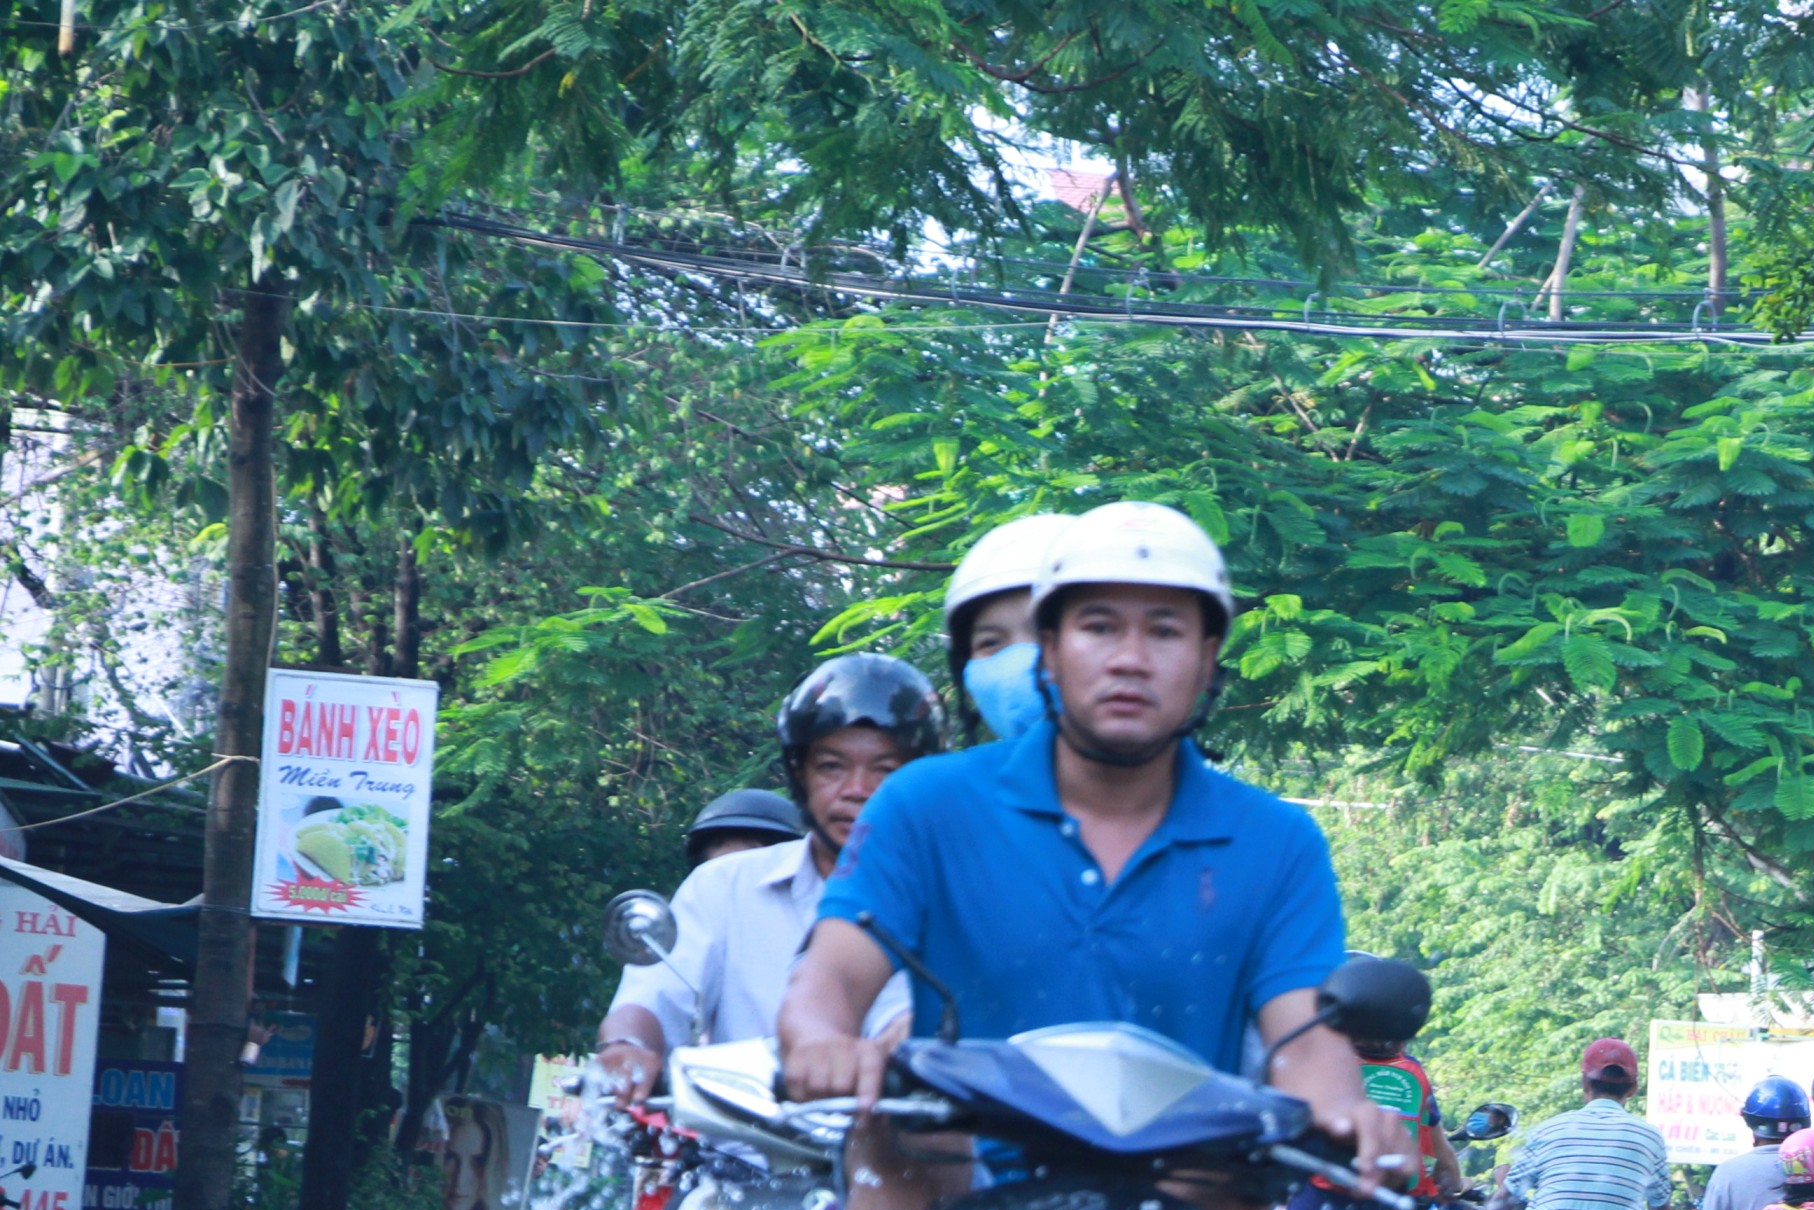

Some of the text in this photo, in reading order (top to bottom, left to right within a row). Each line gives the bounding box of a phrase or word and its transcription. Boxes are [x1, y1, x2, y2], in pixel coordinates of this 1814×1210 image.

[278, 684, 421, 766] BÁNH XÈO
[350, 770, 416, 800] Trung
[15, 905, 77, 938] HẢI
[92, 1068, 177, 1111] OAN
